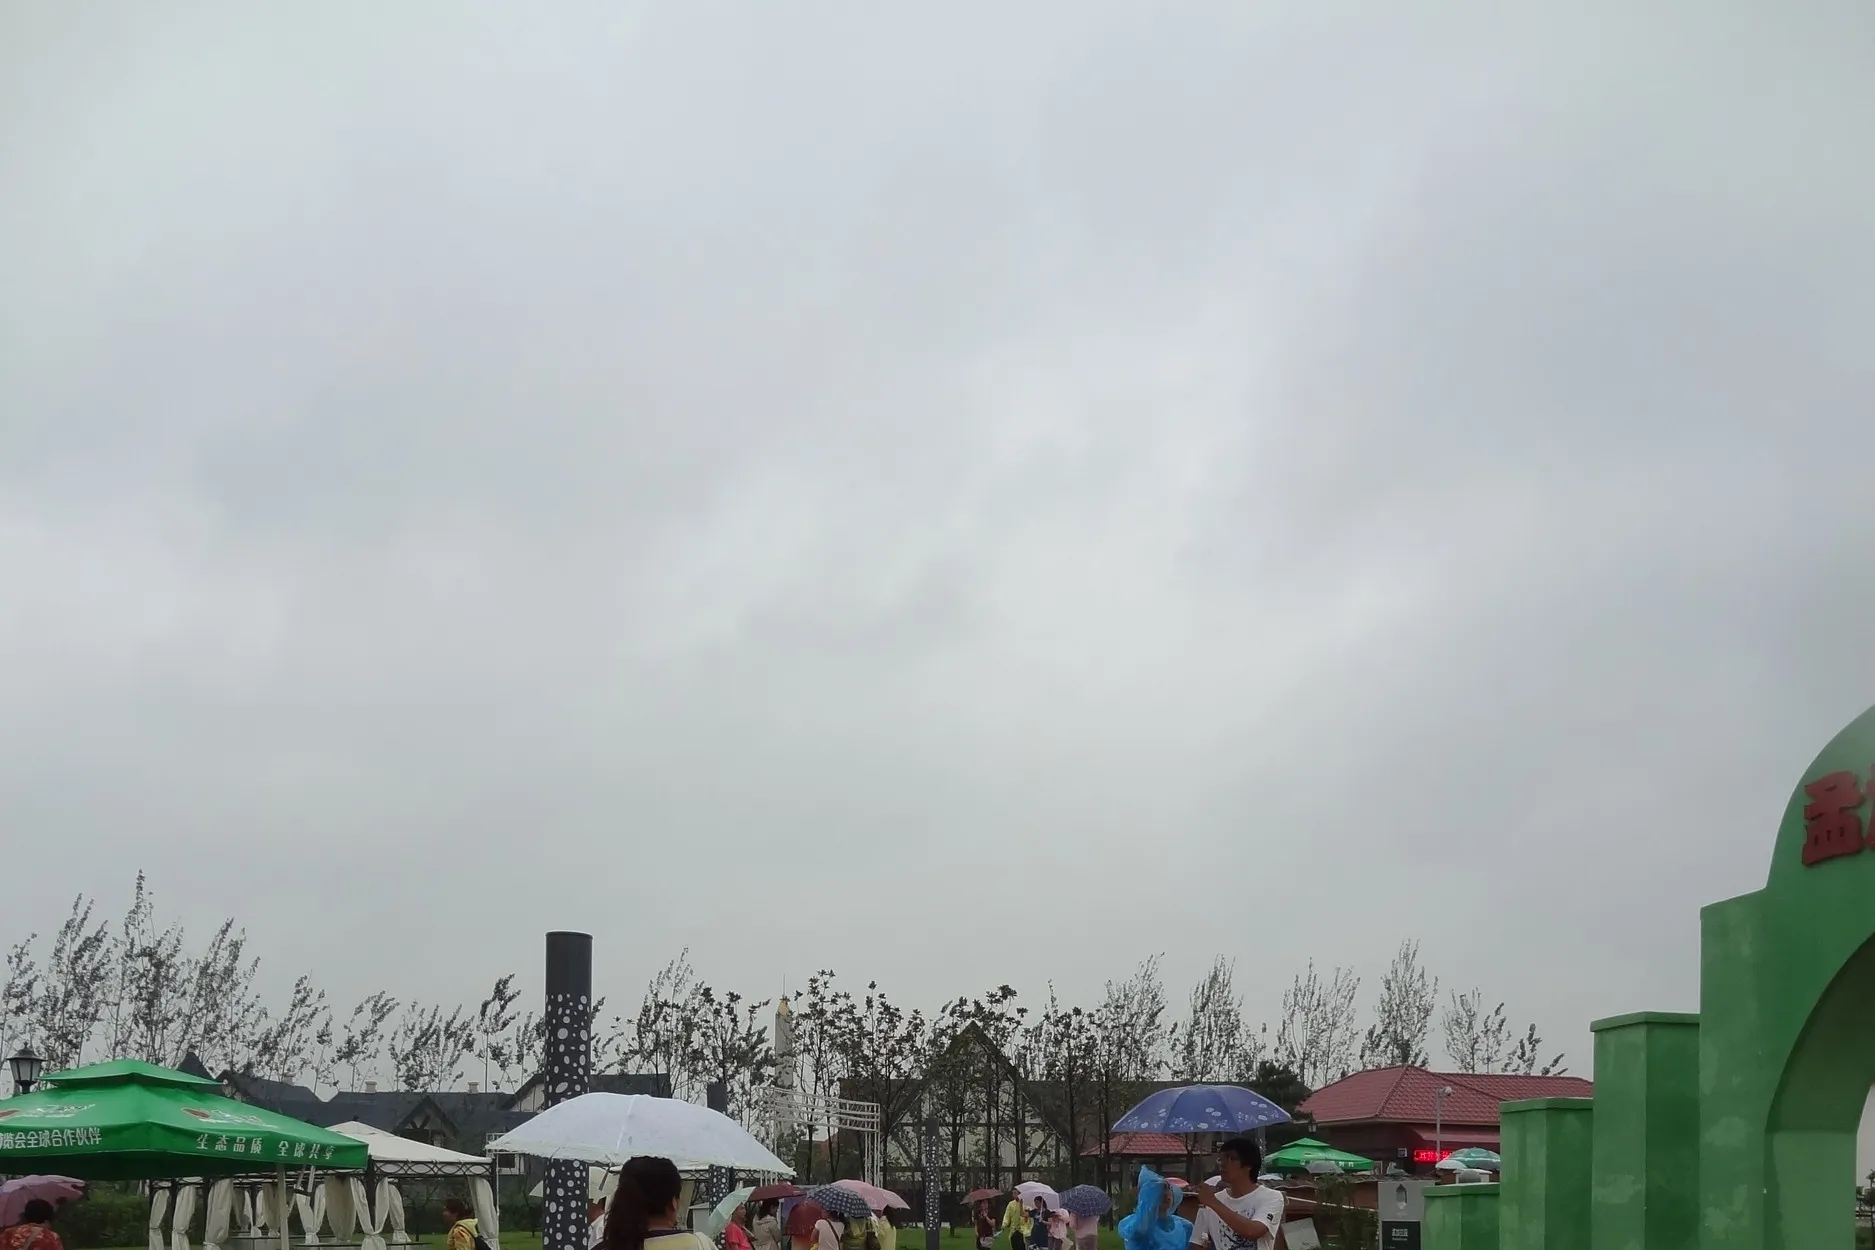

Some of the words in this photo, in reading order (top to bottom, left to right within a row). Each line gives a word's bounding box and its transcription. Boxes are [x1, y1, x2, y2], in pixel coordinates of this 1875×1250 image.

[1801, 764, 1875, 868] 孟
[0, 1127, 102, 1149] 览会全球合作伙伴
[196, 1134, 263, 1154] 生态品质
[277, 1140, 336, 1160] 全球共享
